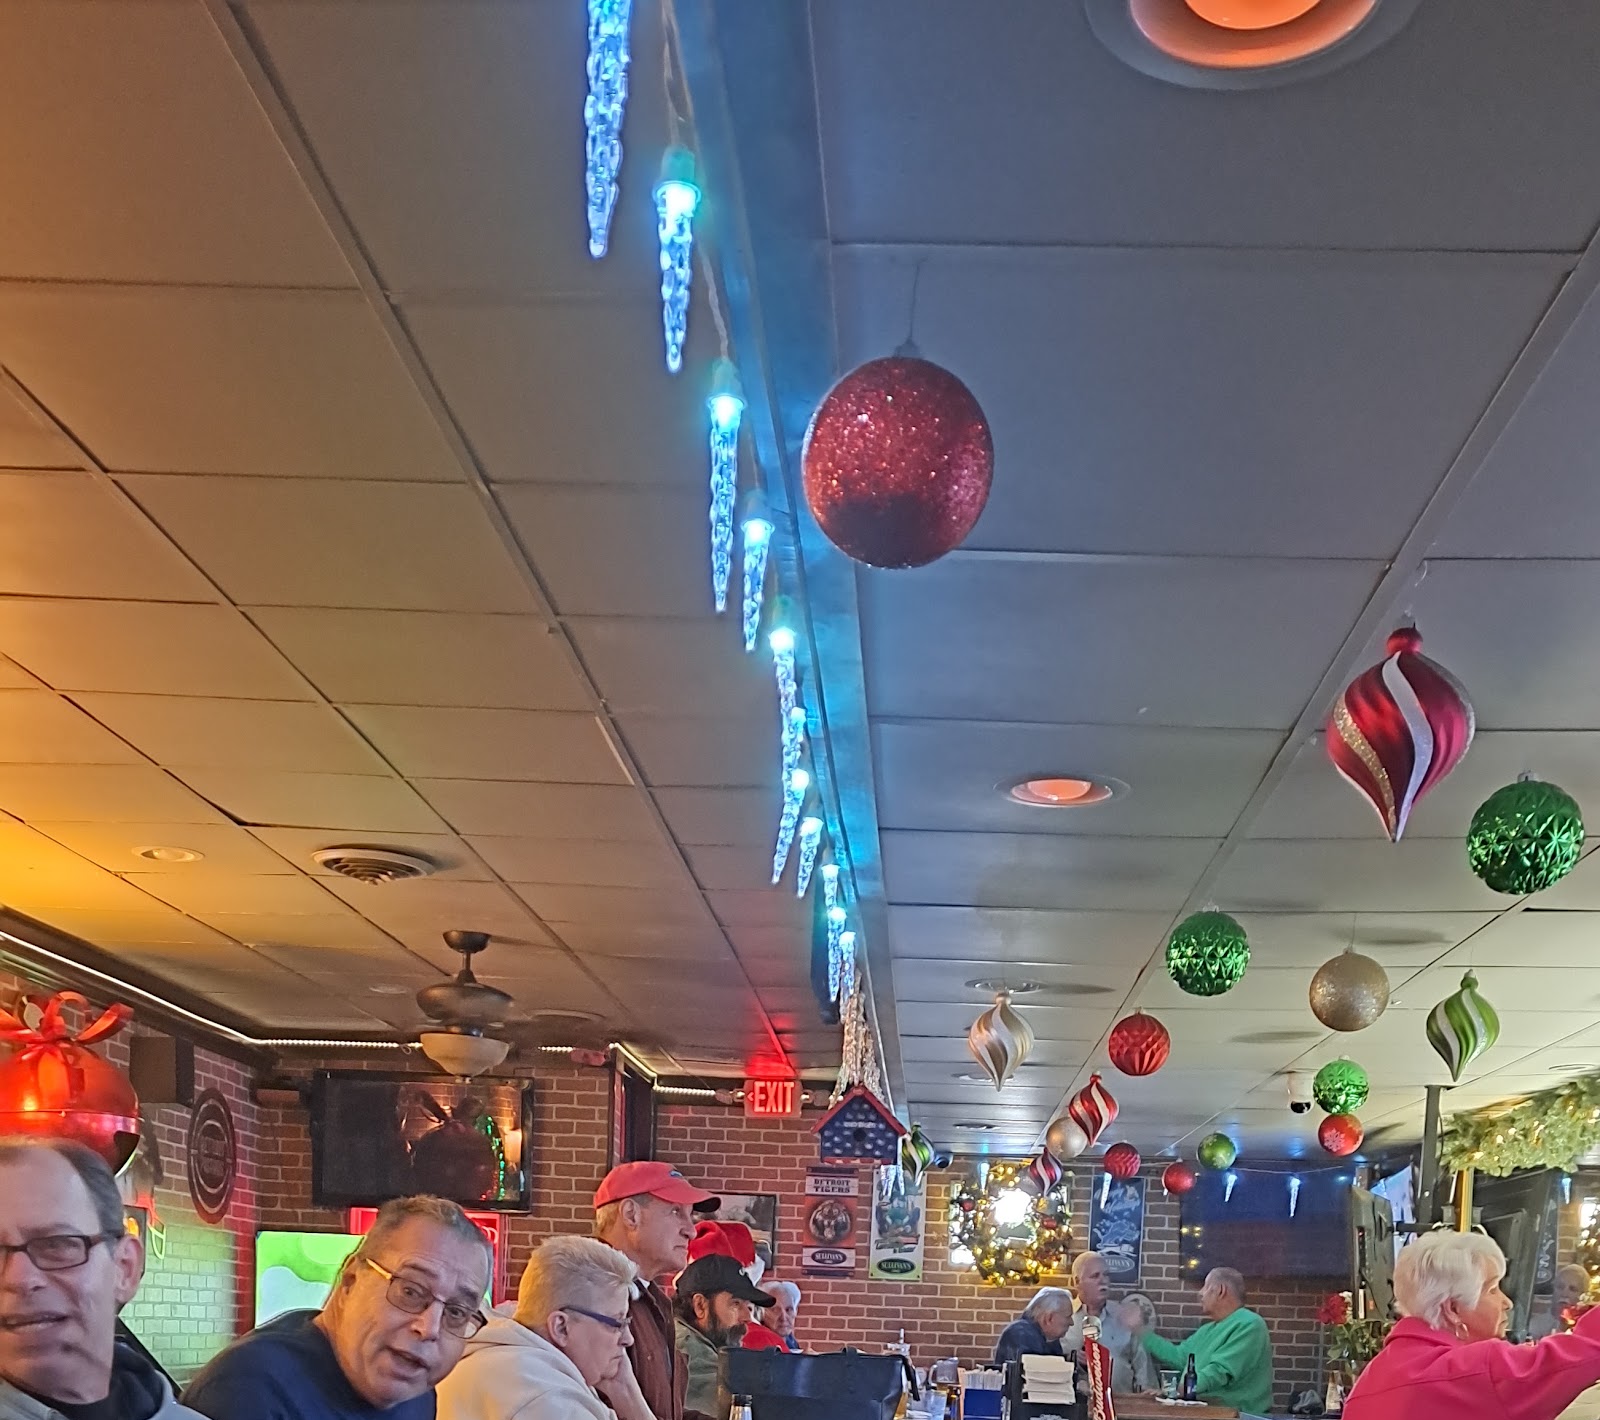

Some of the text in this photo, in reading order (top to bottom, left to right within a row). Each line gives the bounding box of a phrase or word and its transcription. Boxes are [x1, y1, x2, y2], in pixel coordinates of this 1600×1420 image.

[754, 1081, 794, 1112] EXIT
[814, 1178, 850, 1186] DETROIT
[813, 1185, 850, 1193] TIGERS
